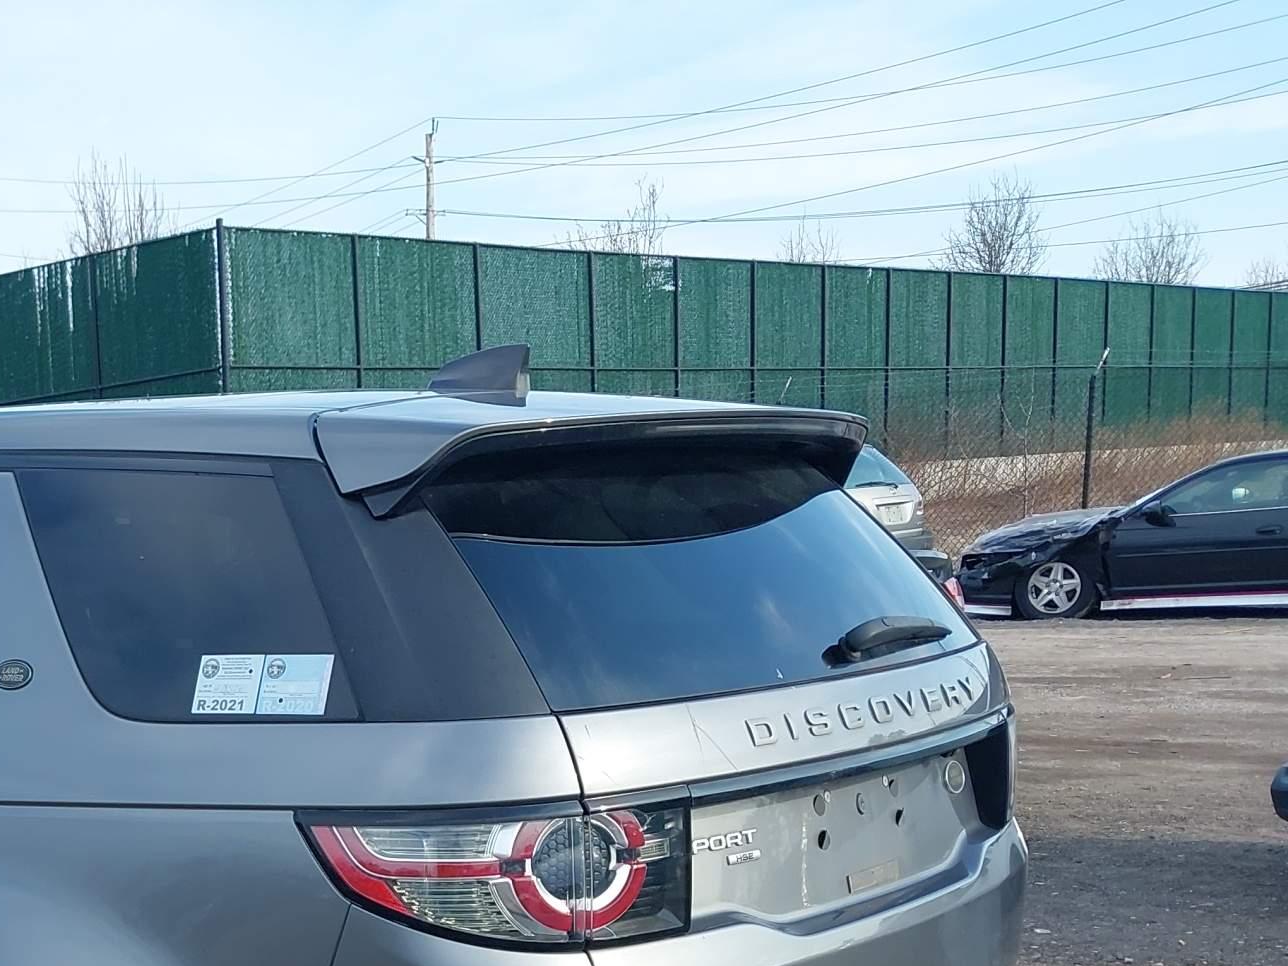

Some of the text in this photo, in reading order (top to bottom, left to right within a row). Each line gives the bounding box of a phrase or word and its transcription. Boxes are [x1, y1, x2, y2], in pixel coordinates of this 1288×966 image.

[197, 699, 244, 711] R-2021
[744, 676, 975, 747] DISCOVERY
[692, 828, 757, 855] PORT
